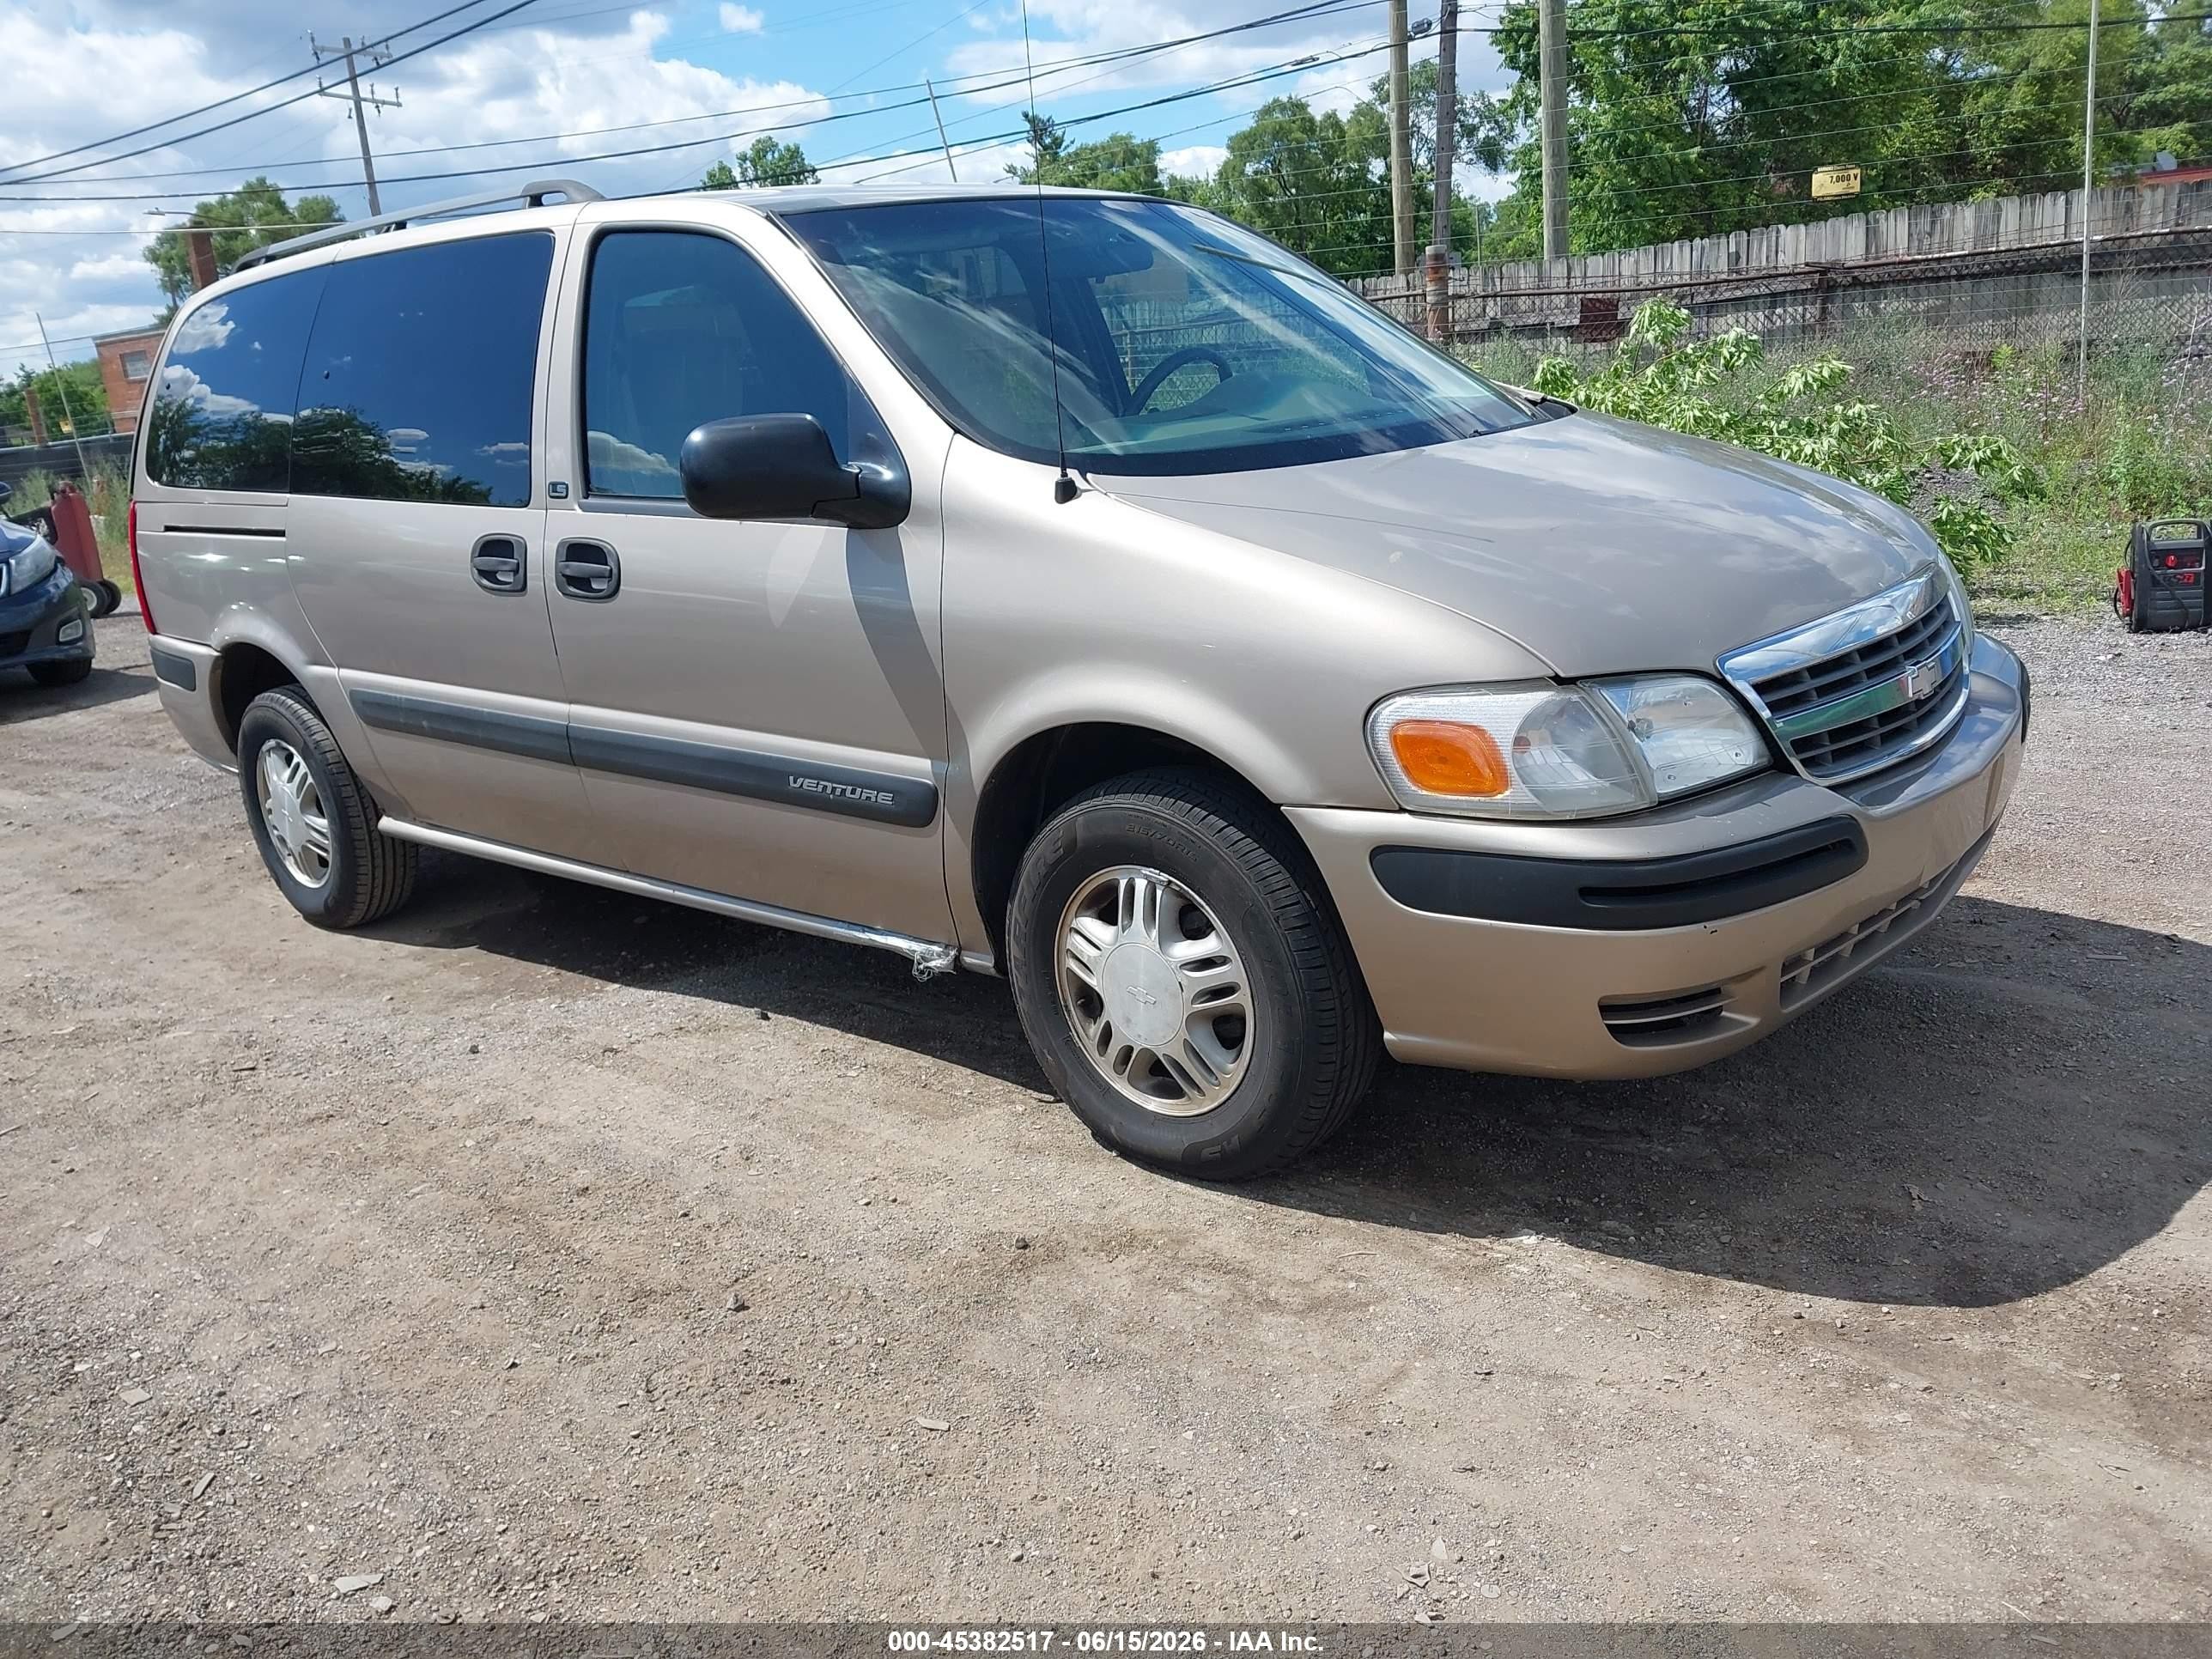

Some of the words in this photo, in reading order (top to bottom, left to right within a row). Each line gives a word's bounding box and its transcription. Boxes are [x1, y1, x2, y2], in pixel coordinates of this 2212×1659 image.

[1829, 173, 1851, 185] 7,000
[1853, 173, 1858, 181] V
[550, 483, 566, 495] LS
[788, 775, 894, 805] VENTURE
